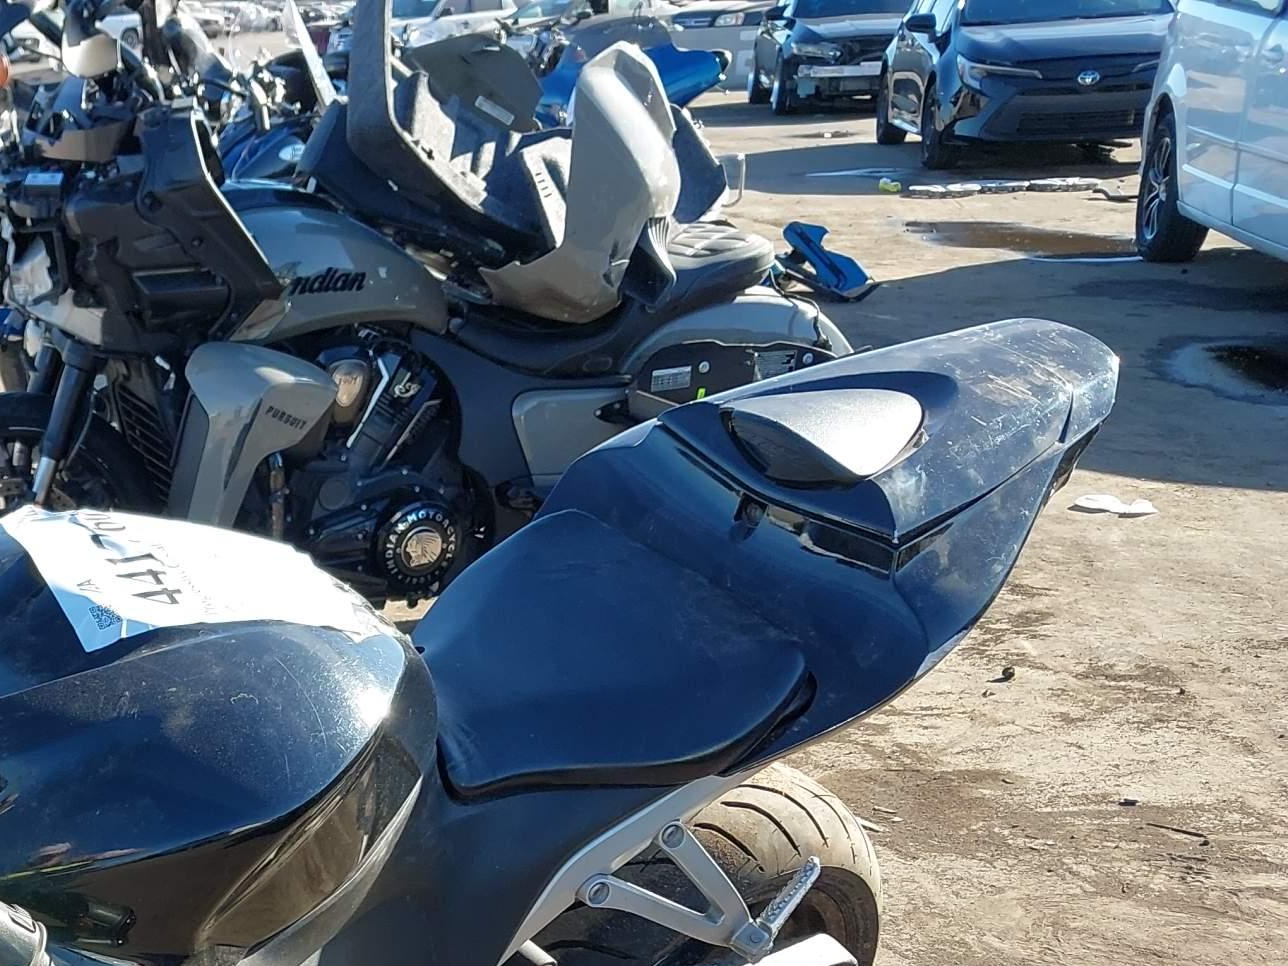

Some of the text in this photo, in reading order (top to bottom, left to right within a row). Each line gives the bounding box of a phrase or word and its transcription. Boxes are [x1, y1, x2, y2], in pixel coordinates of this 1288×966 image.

[287, 267, 367, 297] ndian
[265, 405, 308, 430] PURSUIT
[384, 521, 406, 575] INDIAN
